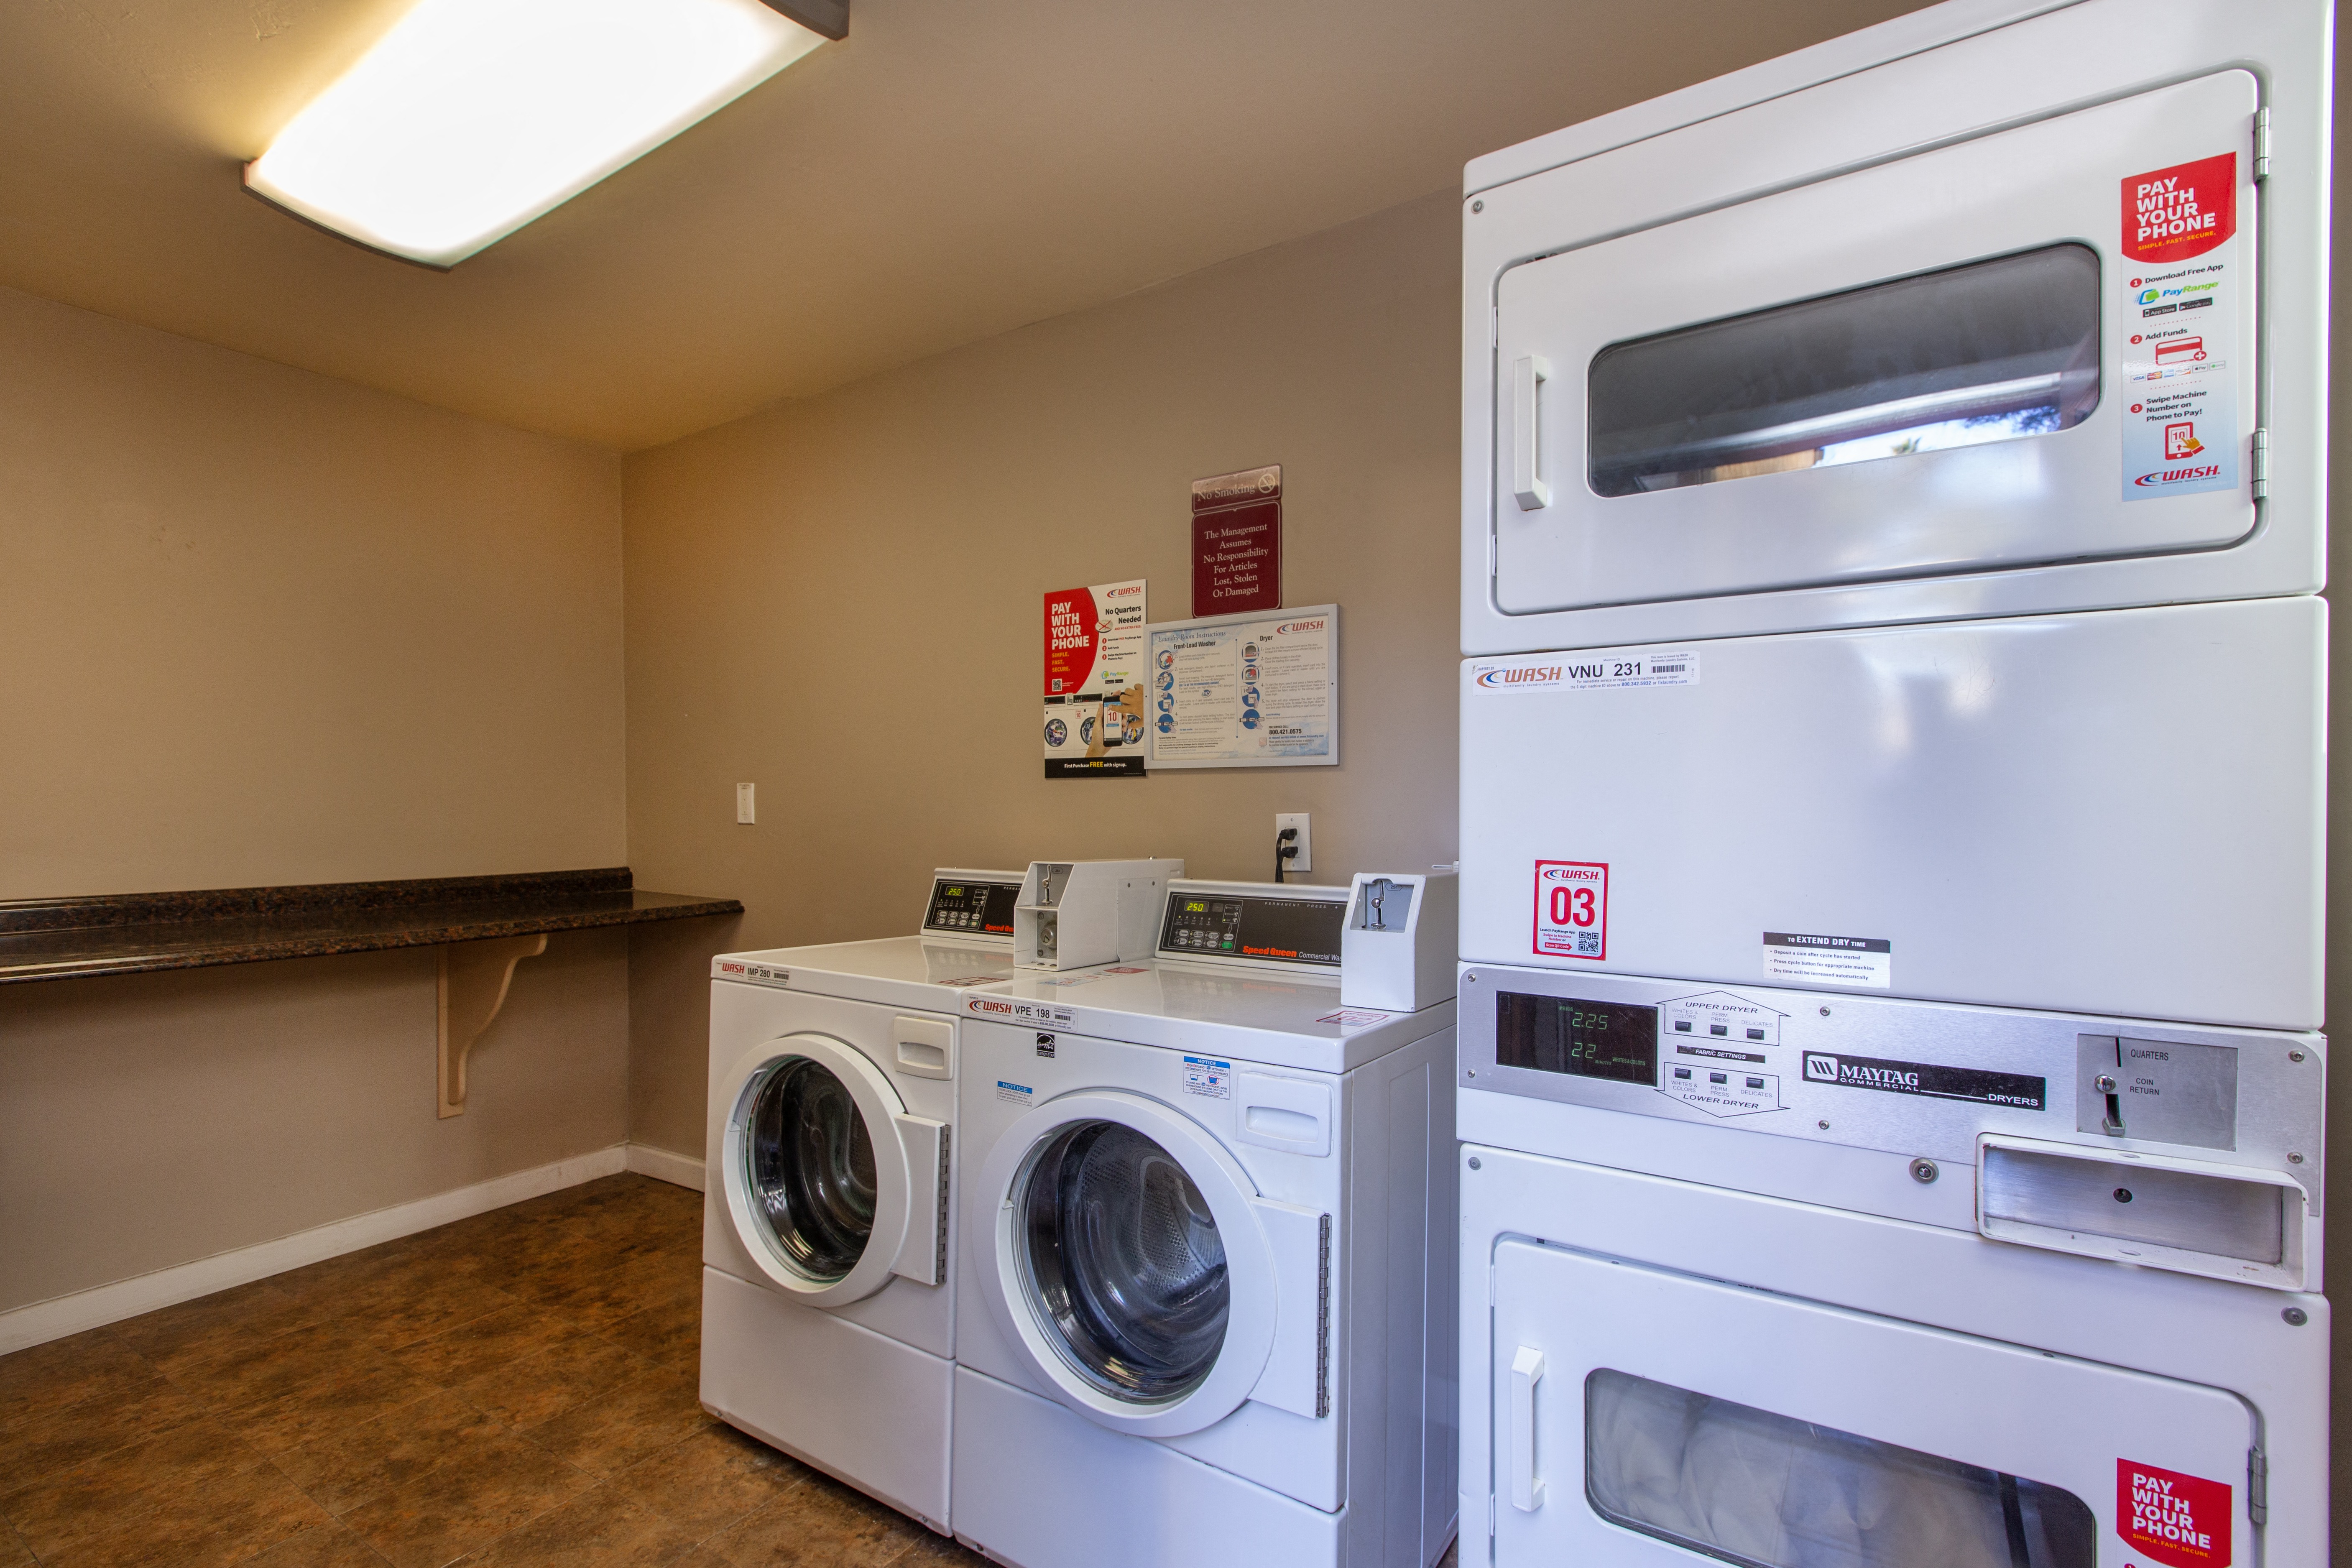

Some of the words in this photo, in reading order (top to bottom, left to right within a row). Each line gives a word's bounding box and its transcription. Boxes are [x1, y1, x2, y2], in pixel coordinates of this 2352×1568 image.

[2137, 176, 2178, 199] PAY
[2137, 188, 2194, 213] WITH
[2136, 202, 2199, 227] YOUR
[2138, 212, 2216, 242] PHONE
[2138, 241, 2164, 251] SIMPLE.
[2187, 230, 2216, 241] SECURE.
[2145, 271, 2185, 283] Download
[2163, 281, 2219, 297] PayRange
[2163, 328, 2188, 337] Funds
[2172, 391, 2206, 400] Machine
[2146, 403, 2179, 413] Number
[2146, 413, 2172, 422] Phone
[2184, 409, 2202, 417] Pay!
[1198, 491, 1212, 501] No
[1215, 484, 1255, 498] Smoking
[1221, 524, 1267, 537] Management
[1220, 539, 1251, 549] Assumes
[1217, 547, 1269, 562] Responsibility
[1228, 561, 1257, 572] Articles
[1234, 575, 1257, 583] Stolen
[1225, 585, 1259, 596] Damaged
[1052, 602, 1071, 615] PAY
[1114, 606, 1141, 615] Quarters
[1051, 613, 1079, 626] WITH
[1119, 615, 1141, 624] Needed
[1052, 625, 1081, 638] YOUR
[1052, 636, 1089, 650] PHONE
[1505, 667, 1562, 683] WASH
[1568, 664, 1603, 678] VNU
[1614, 662, 1641, 676] 231
[1108, 712, 1117, 721] 10
[1550, 886, 1595, 927] 03
[1797, 936, 1829, 945] EXTEND
[1243, 945, 1269, 955] Speed
[1270, 947, 1297, 957] Queen
[1299, 952, 1329, 960] Commercial
[722, 963, 744, 973] WASH
[760, 969, 770, 978] 280
[1015, 1005, 1031, 1016] VPE
[1036, 1009, 1050, 1019] 198
[1572, 1012, 1608, 1030] 2.25
[1572, 1042, 1596, 1059] 22
[2131, 1049, 2168, 1061] QUARTERS
[1840, 1065, 1918, 1086] MAYTAG
[1003, 1083, 1028, 1092] NOTICE
[1740, 1089, 1772, 1098] DELICATES
[1840, 1078, 1919, 1092] COMMERCIAL
[1989, 1093, 2038, 1106] DRYERS
[2130, 1086, 2159, 1095] RETURN
[1683, 1094, 1720, 1103] LOWER
[1723, 1099, 1759, 1109] DRYER
[2133, 1473, 2173, 1494] PAY
[2132, 1487, 2189, 1514] WITH
[2132, 1501, 2193, 1530] YOUR
[2133, 1516, 2211, 1549] PHONE
[2133, 1533, 2159, 1545] SIMPLE.
[2161, 1541, 2179, 1550] FAST.
[2182, 1547, 2211, 1559] SECURE.
